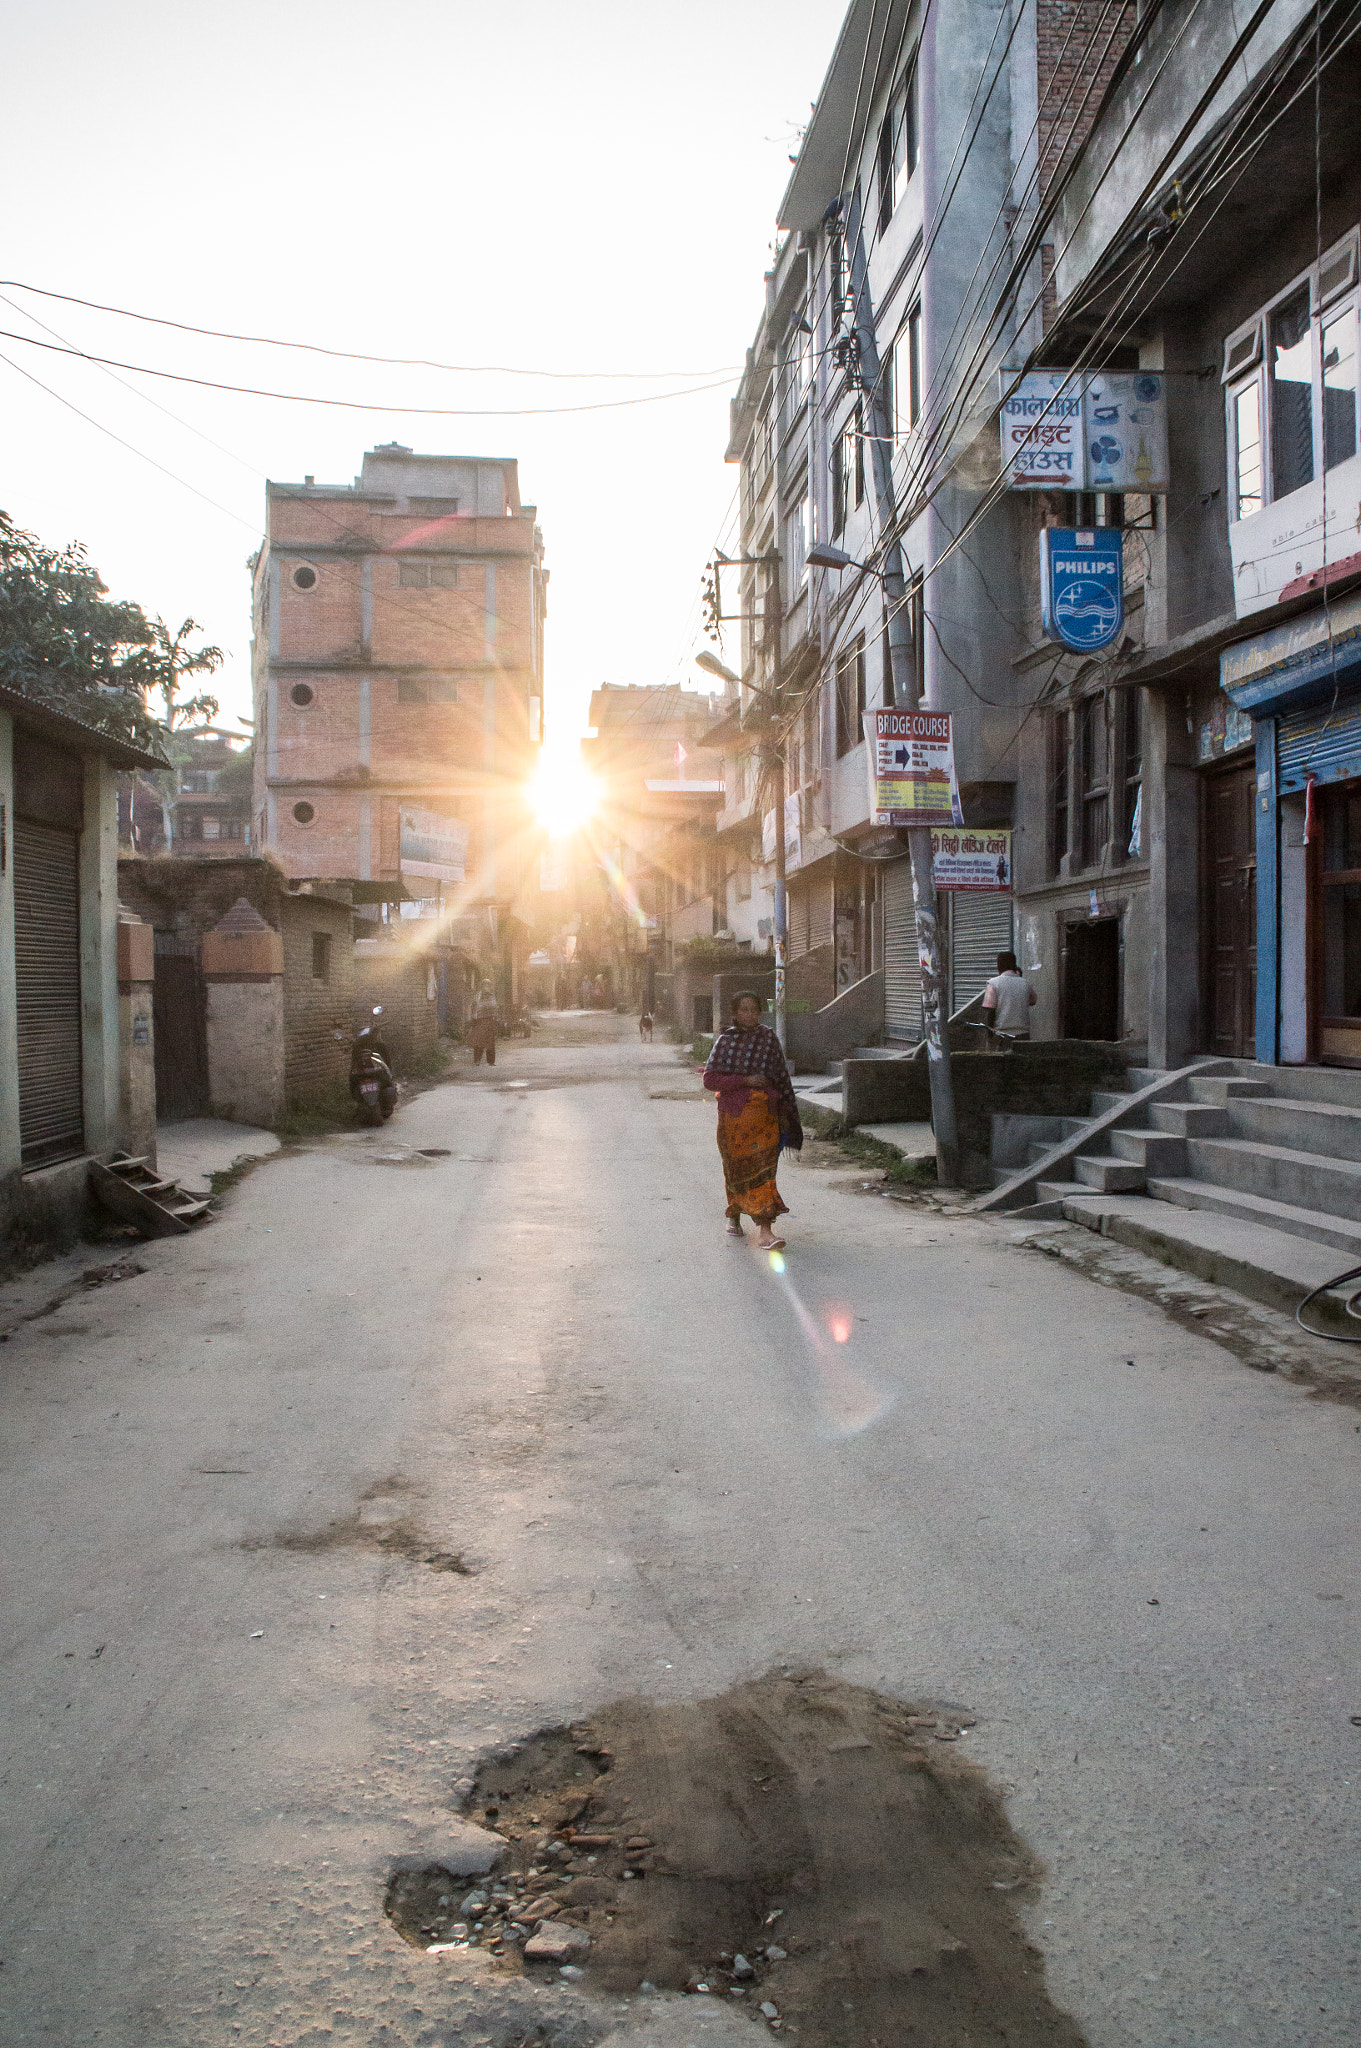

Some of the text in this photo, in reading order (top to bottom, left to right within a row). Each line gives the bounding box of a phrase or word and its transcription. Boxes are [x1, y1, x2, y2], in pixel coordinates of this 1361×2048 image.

[1011, 425, 1073, 448] लाइट
[1014, 451, 1074, 471] हाउस
[1056, 561, 1115, 575] PHILIPS
[877, 714, 948, 737] BRIDGE COURSE
